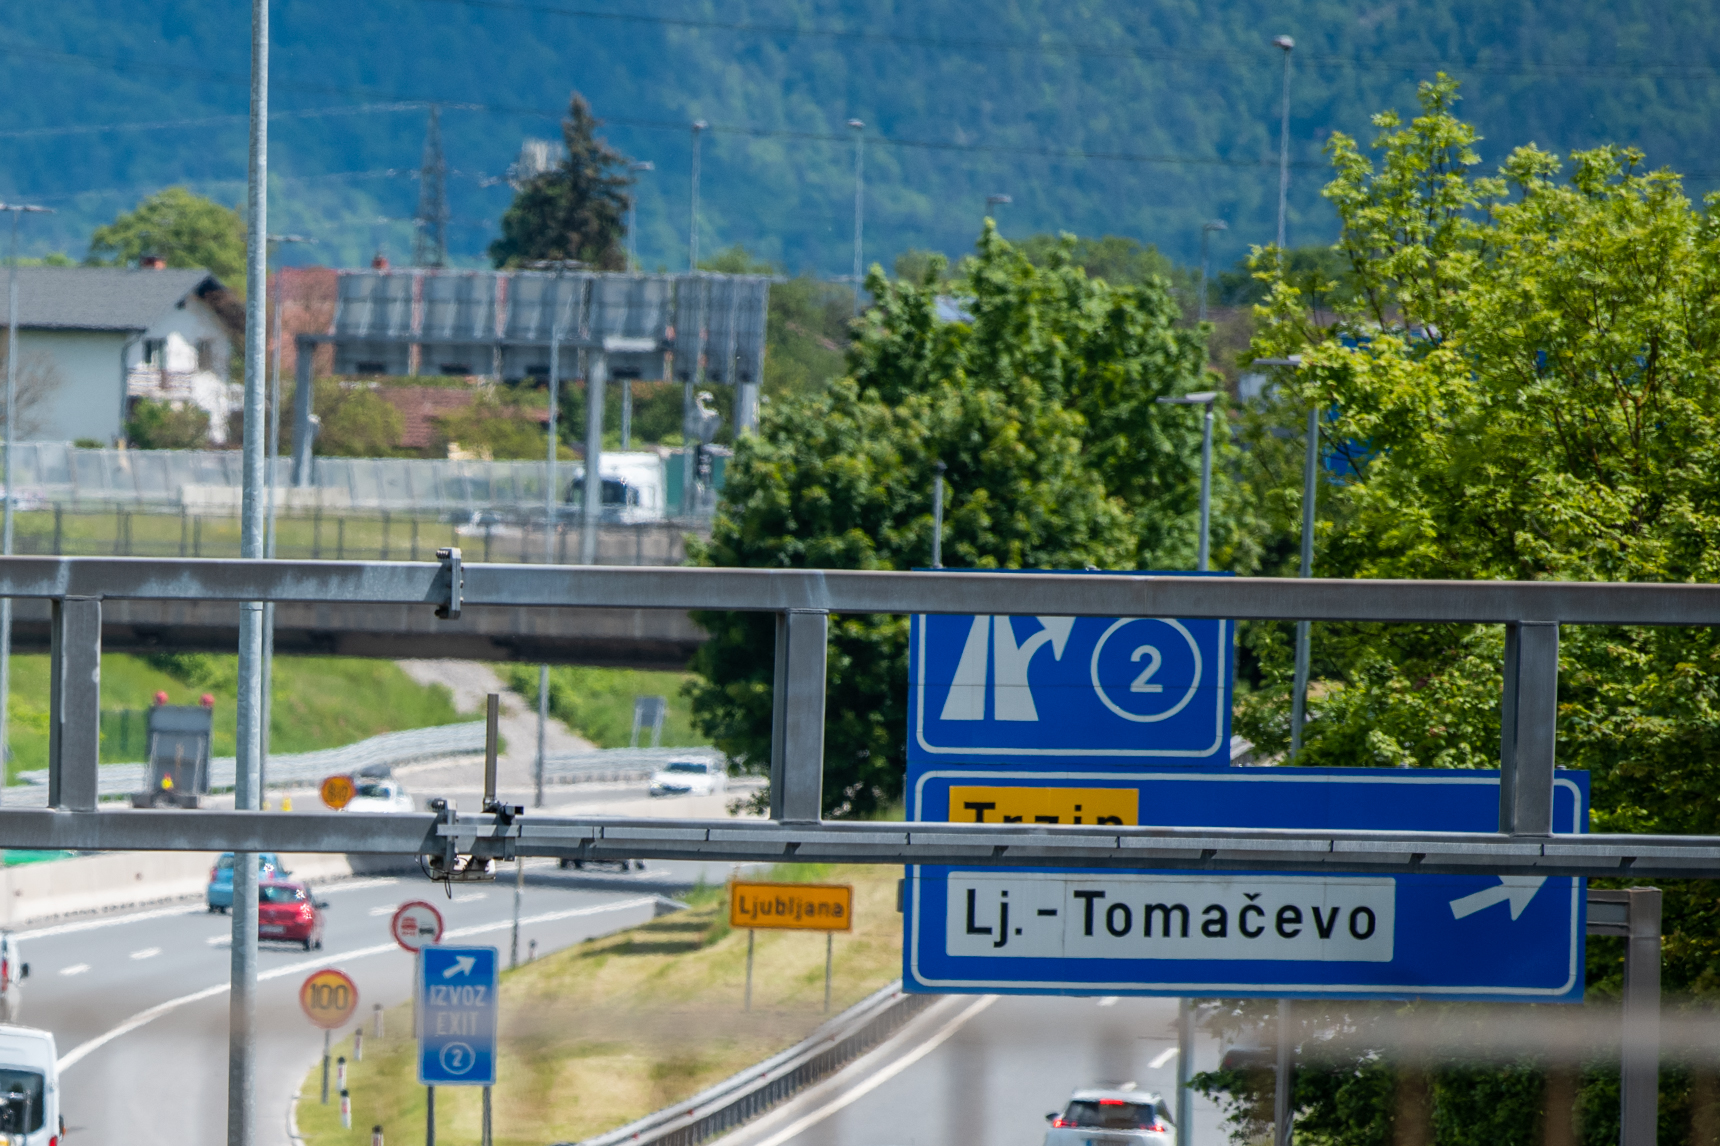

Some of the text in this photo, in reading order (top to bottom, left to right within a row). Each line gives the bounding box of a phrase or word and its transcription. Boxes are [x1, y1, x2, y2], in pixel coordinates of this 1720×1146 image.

[1129, 644, 1164, 693] 2
[739, 895, 844, 922] Ljubljana
[310, 983, 350, 1011] 100
[431, 984, 487, 1007] IZVOZ
[436, 1011, 479, 1036] EXIT
[451, 1050, 464, 1068] 2
